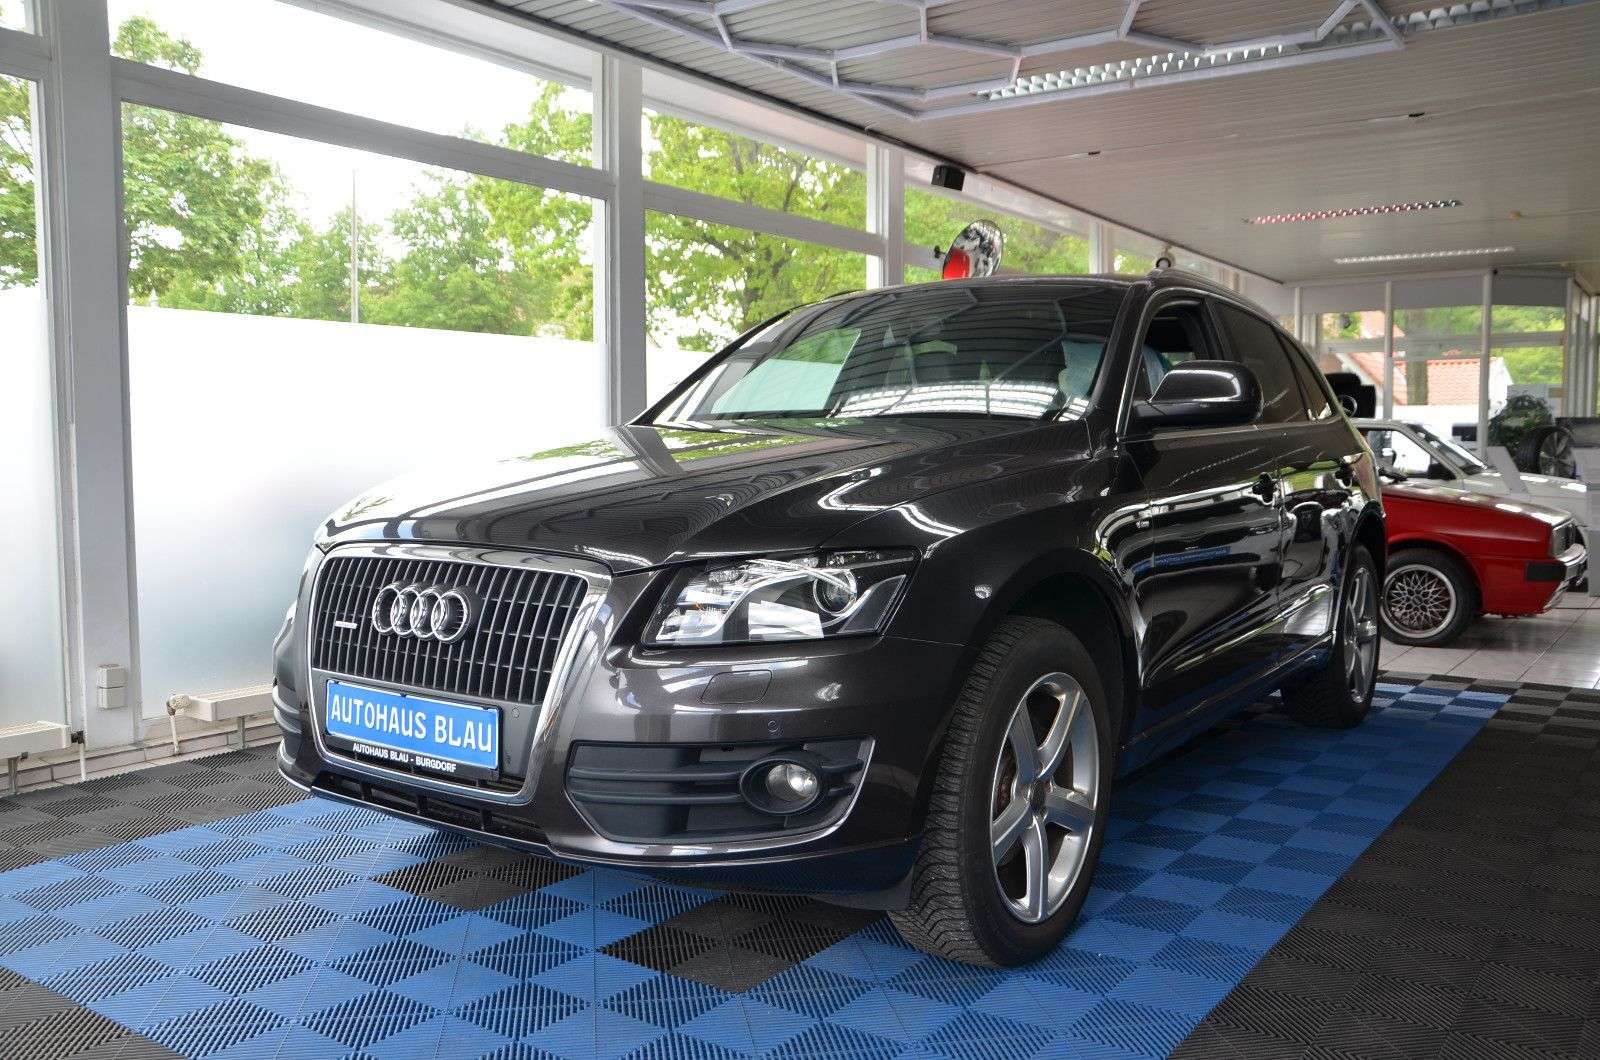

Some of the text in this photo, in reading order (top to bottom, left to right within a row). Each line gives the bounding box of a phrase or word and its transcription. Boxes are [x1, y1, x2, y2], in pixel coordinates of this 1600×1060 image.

[331, 694, 492, 753] AUTOHAUS BLAU
[353, 743, 389, 759] AUTOHAUS
[390, 751, 409, 763] BLAU
[416, 756, 457, 772] BURGDORF
